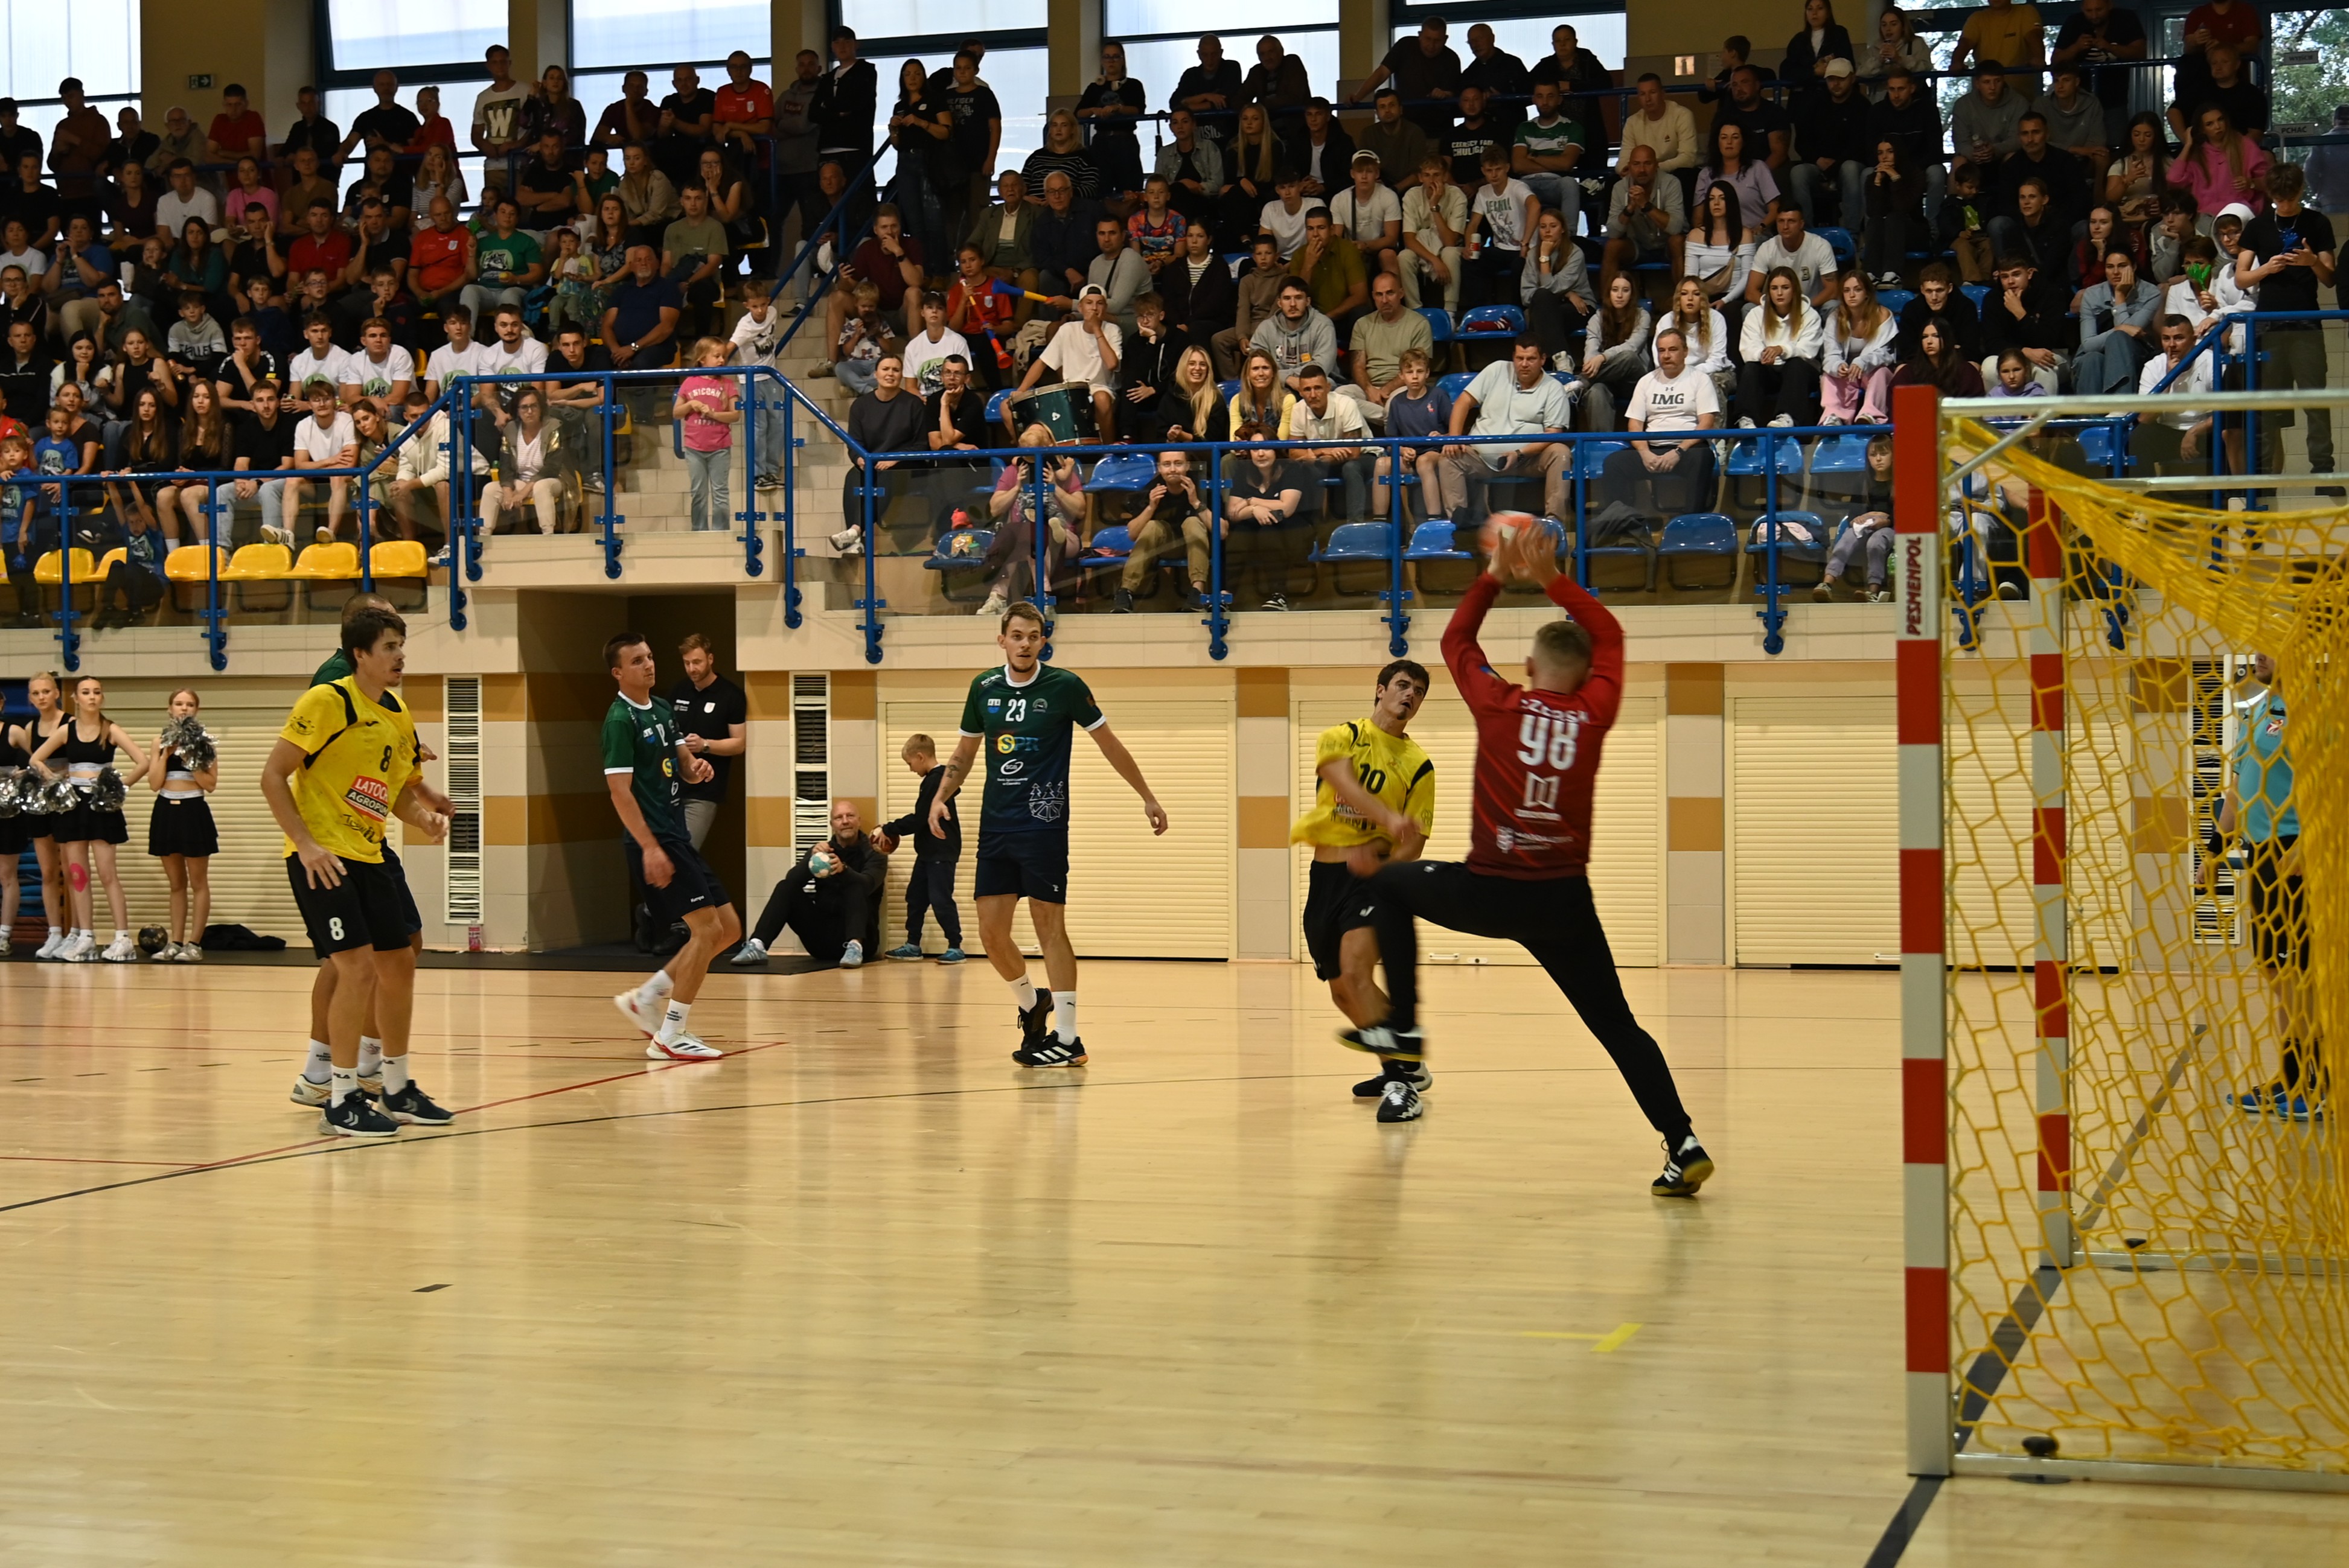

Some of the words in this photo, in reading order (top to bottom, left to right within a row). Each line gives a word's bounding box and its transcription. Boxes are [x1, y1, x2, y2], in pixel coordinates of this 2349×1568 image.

[1651, 393, 1684, 405] IMG
[1906, 536, 1922, 636] PESMENPOL
[1005, 698, 1027, 722] 23
[380, 745, 392, 773] 8
[1358, 763, 1386, 794] 10
[329, 917, 345, 941] 8
